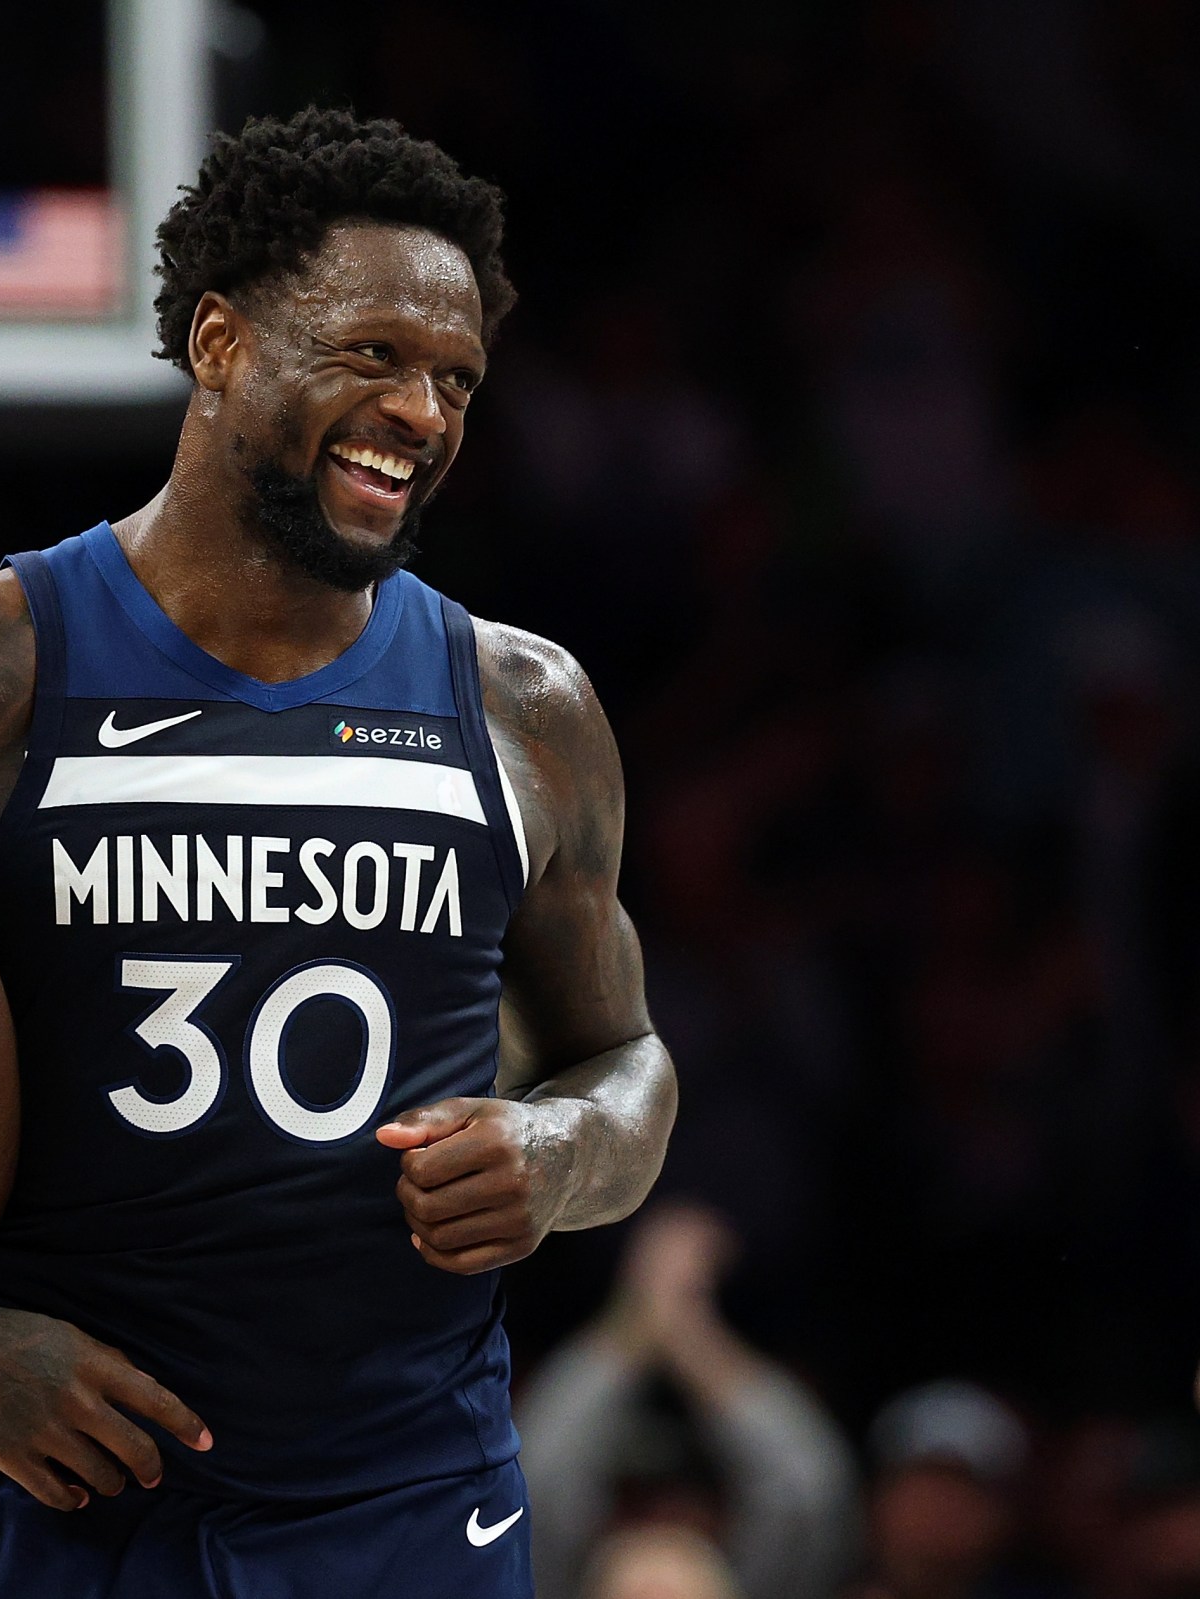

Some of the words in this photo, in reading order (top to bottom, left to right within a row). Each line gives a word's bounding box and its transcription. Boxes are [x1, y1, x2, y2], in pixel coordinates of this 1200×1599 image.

[354, 725, 443, 751] sezzle
[52, 833, 463, 938] MINNESOTA
[106, 957, 394, 1144] 30
